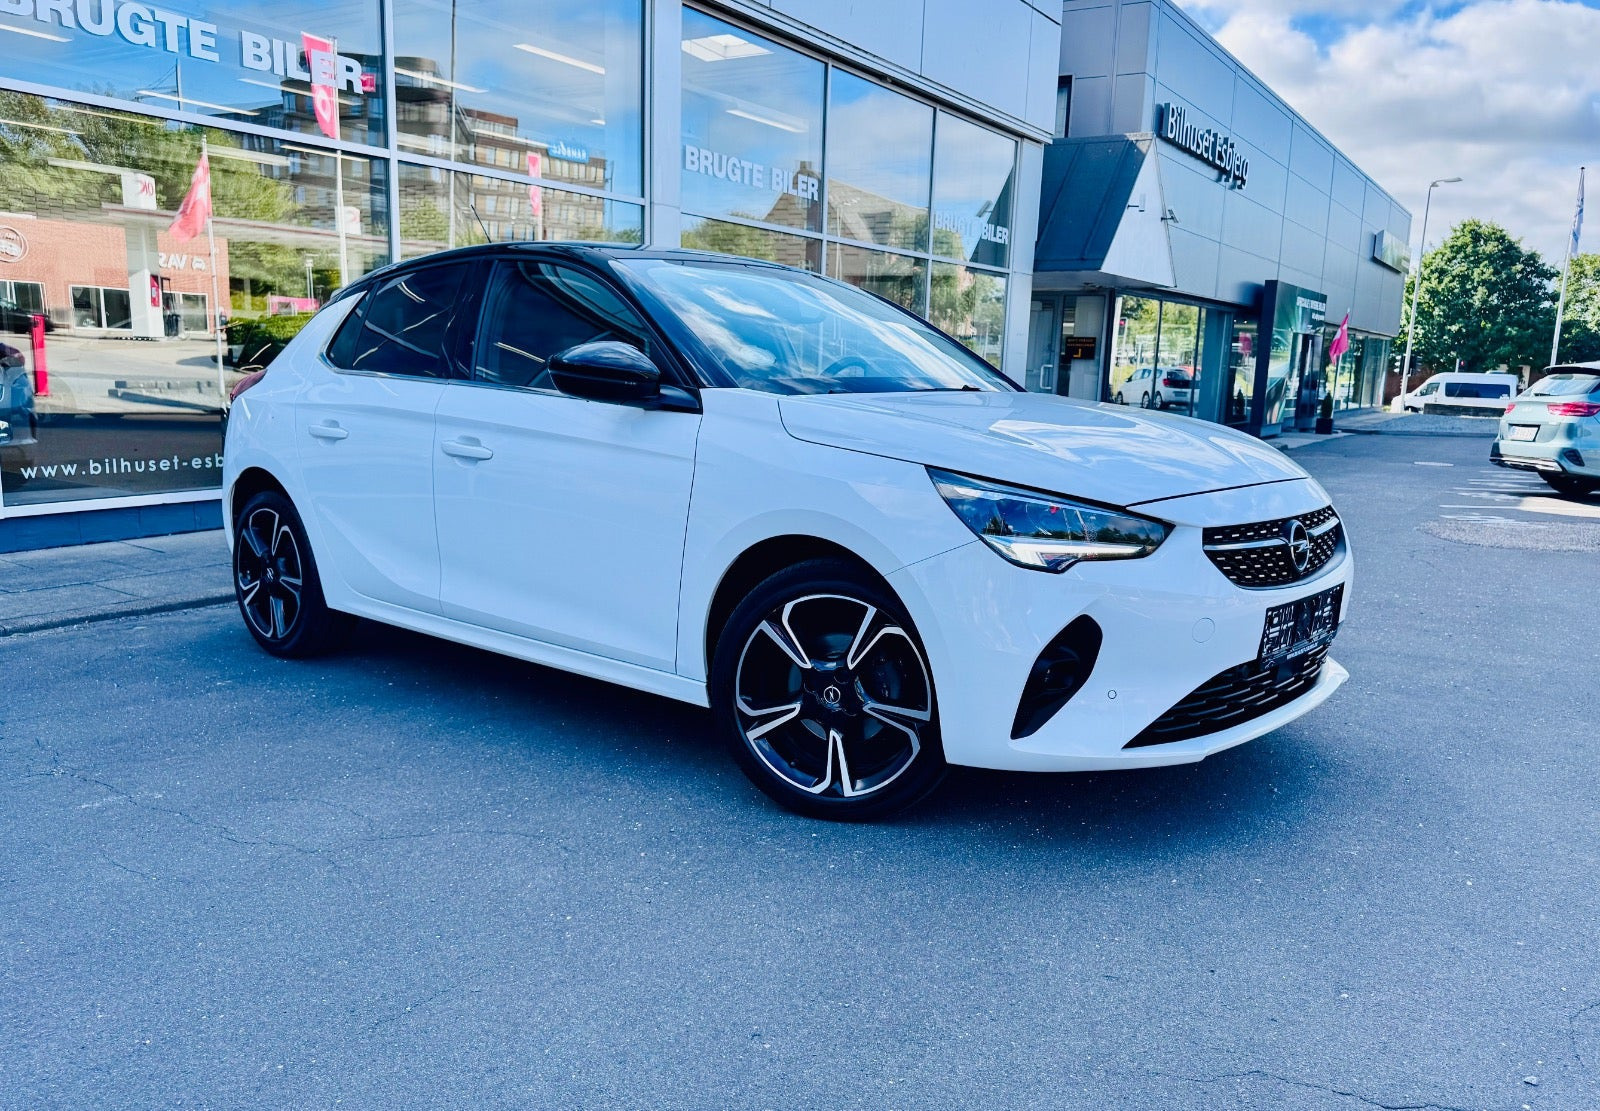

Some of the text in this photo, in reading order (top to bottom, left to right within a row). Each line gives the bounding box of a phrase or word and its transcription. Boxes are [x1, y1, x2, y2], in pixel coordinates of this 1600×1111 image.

[241, 30, 364, 95] BILER
[685, 144, 818, 202] BRUGTE BILER
[1167, 103, 1250, 189] Bilhuset Esbjerg
[981, 222, 1009, 245] BILER
